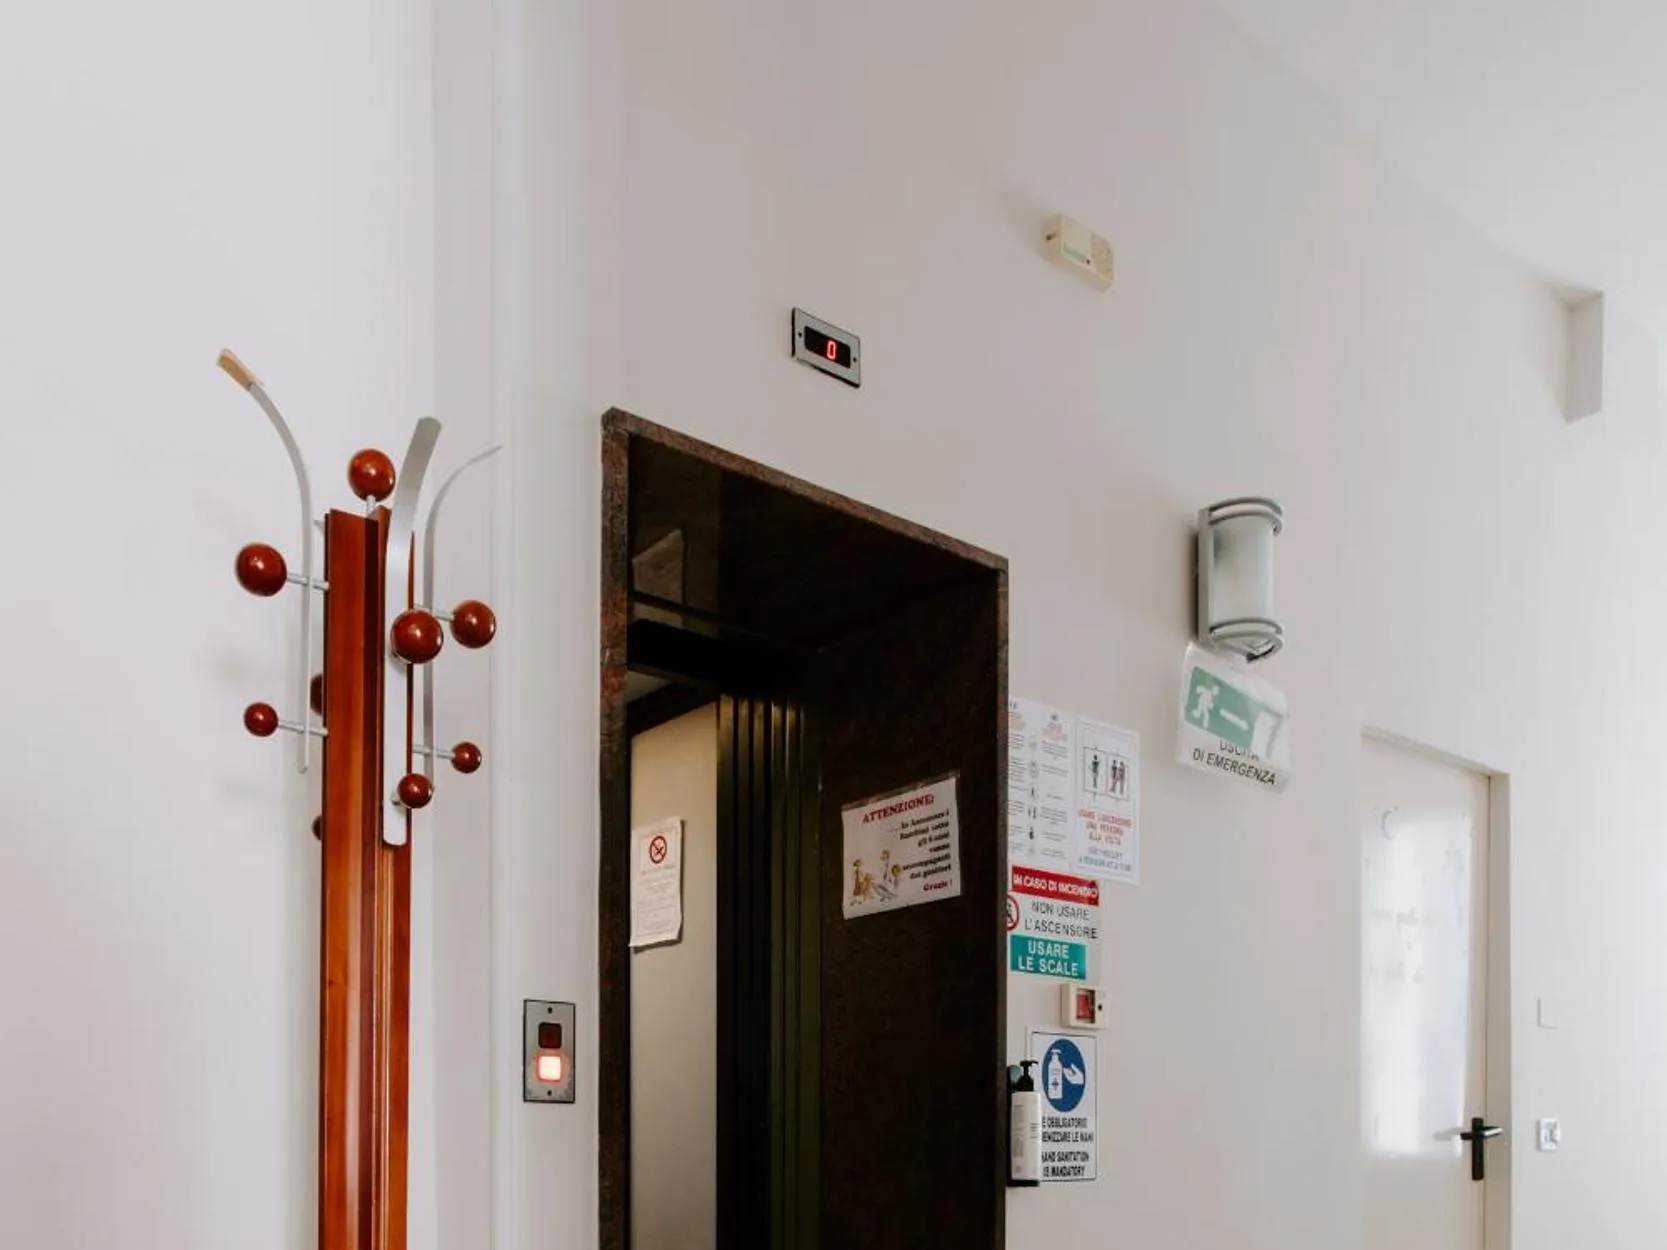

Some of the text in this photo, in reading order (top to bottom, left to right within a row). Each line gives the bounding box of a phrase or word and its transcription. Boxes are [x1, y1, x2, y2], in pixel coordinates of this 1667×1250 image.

[826, 340, 836, 360] 0
[1193, 748, 1275, 785] DI EMERGENZA
[1013, 873, 1098, 897] IN CASO DI INCENDIO
[1032, 900, 1090, 921] NON USARE
[1024, 918, 1098, 939] L'ASCENSORE
[1028, 940, 1070, 959] USARE
[1018, 956, 1079, 976] LE SCALE
[1072, 1131, 1079, 1142] LE
